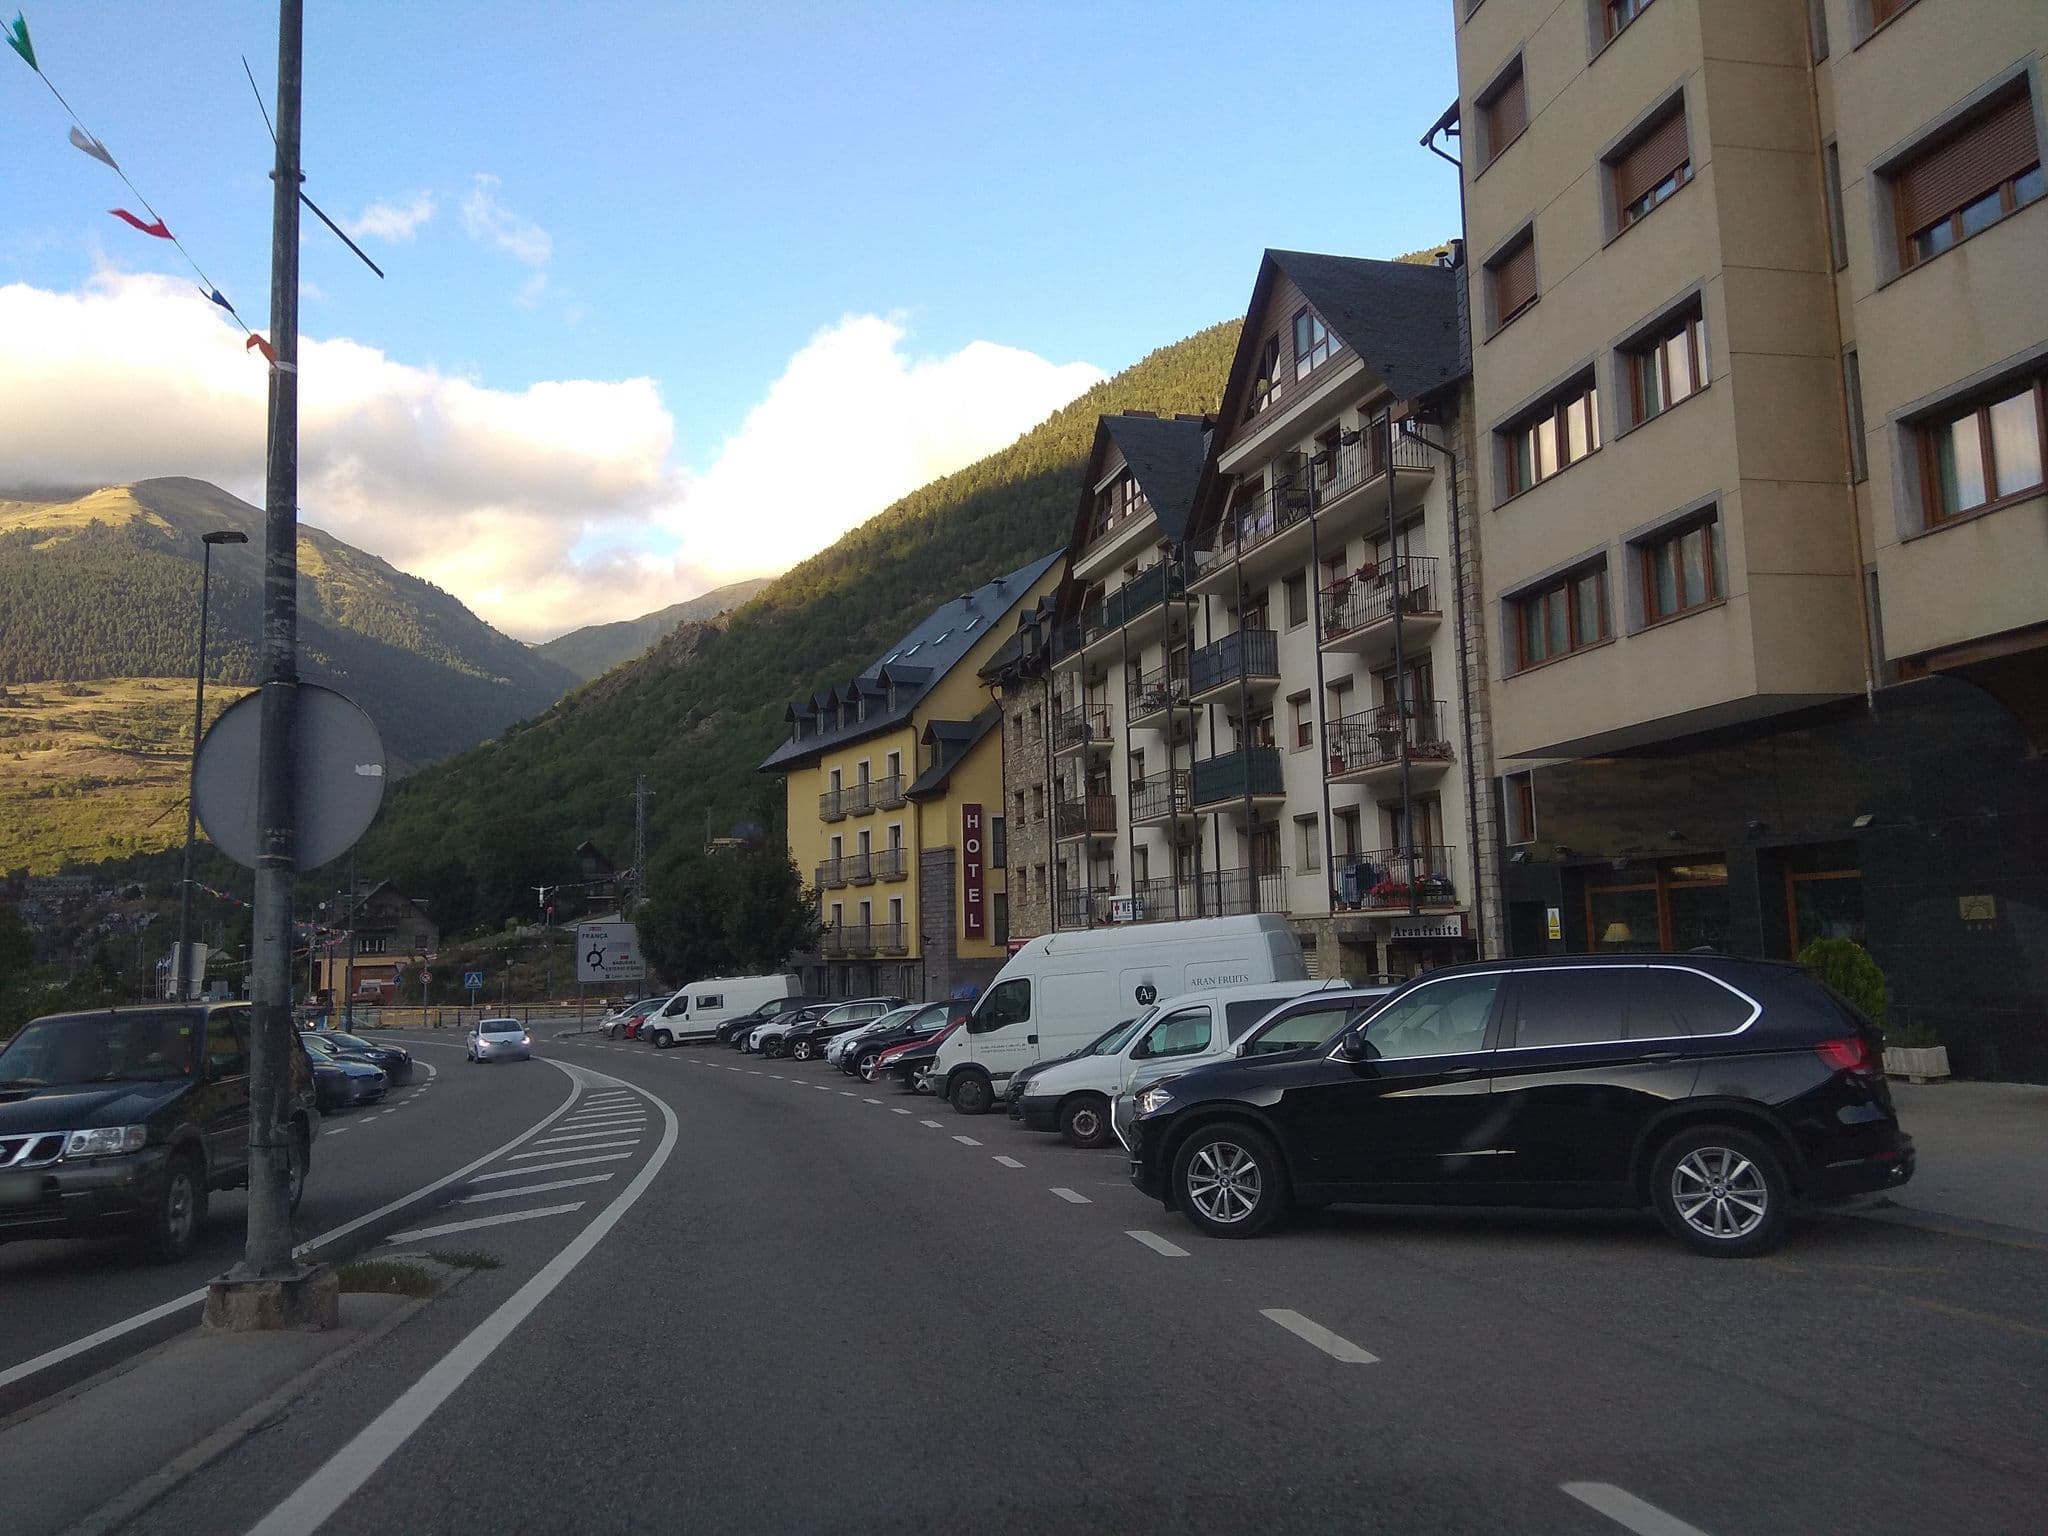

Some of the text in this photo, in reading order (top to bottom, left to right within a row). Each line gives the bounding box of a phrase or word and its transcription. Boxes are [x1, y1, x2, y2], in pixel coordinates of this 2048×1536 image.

[966, 814, 980, 928] HOTEL
[1191, 974, 1249, 986] ARAN FRUITS
